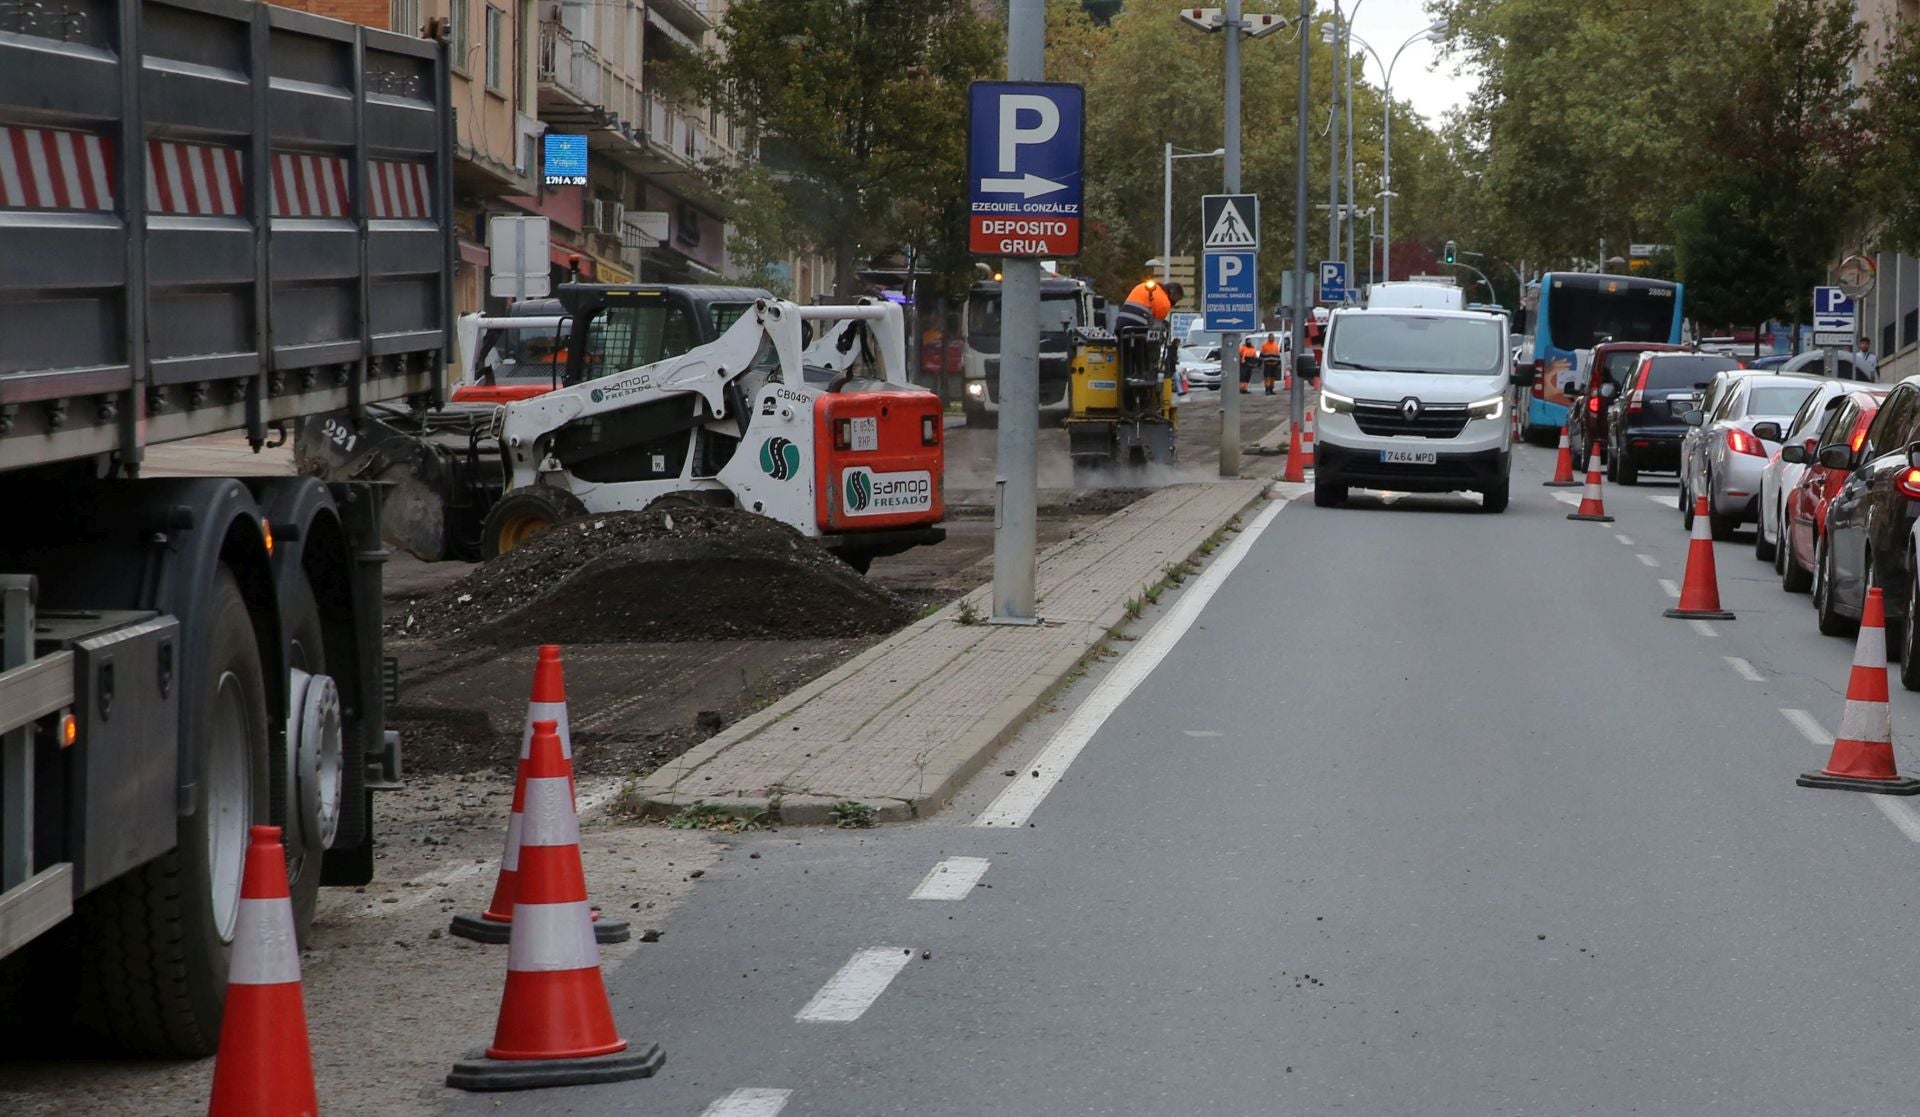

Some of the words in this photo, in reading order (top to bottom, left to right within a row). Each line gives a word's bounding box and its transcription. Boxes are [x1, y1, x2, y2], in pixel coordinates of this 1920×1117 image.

[998, 94, 1060, 173] P
[971, 202, 1021, 212] EZEQUIEL
[1023, 202, 1078, 213] GONZÁLEZ
[982, 220, 1067, 236] DEPOSITO
[999, 239, 1049, 254] GRUA
[1219, 256, 1242, 286] P
[1323, 265, 1338, 285] P
[1828, 289, 1847, 312] P
[322, 418, 357, 452] 221
[1387, 451, 1412, 461] 7464
[1415, 453, 1435, 462] MPD
[874, 495, 929, 507] FRESADO
